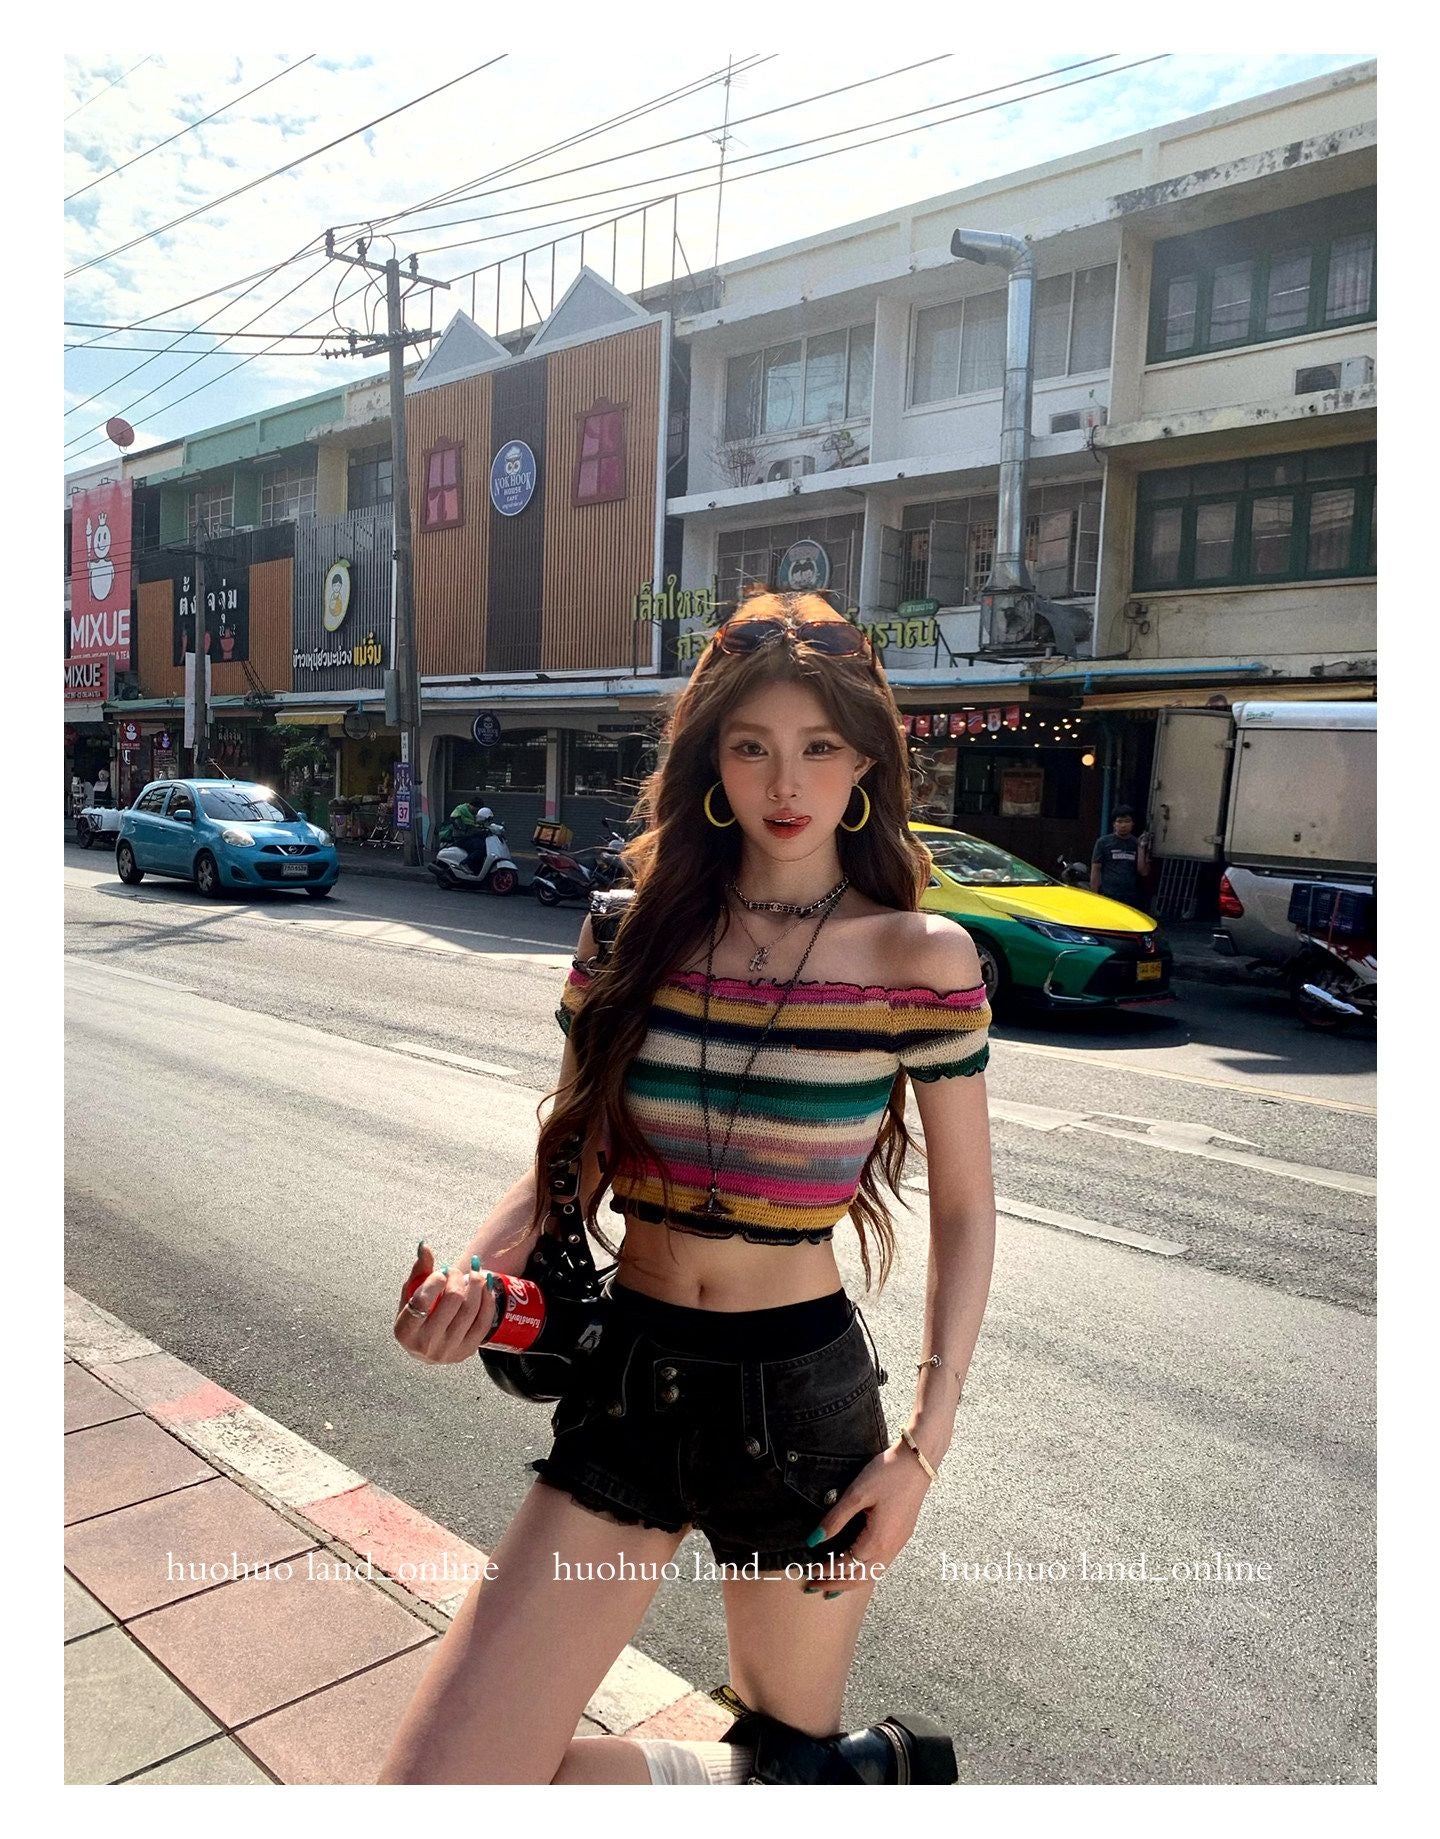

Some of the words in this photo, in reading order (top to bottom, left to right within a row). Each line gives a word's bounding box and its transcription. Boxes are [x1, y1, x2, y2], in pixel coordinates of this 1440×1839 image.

[510, 471, 532, 491] HOOK
[70, 608, 131, 650] MIXUE
[64, 662, 101, 688] MIXUE
[398, 807, 408, 819] 37
